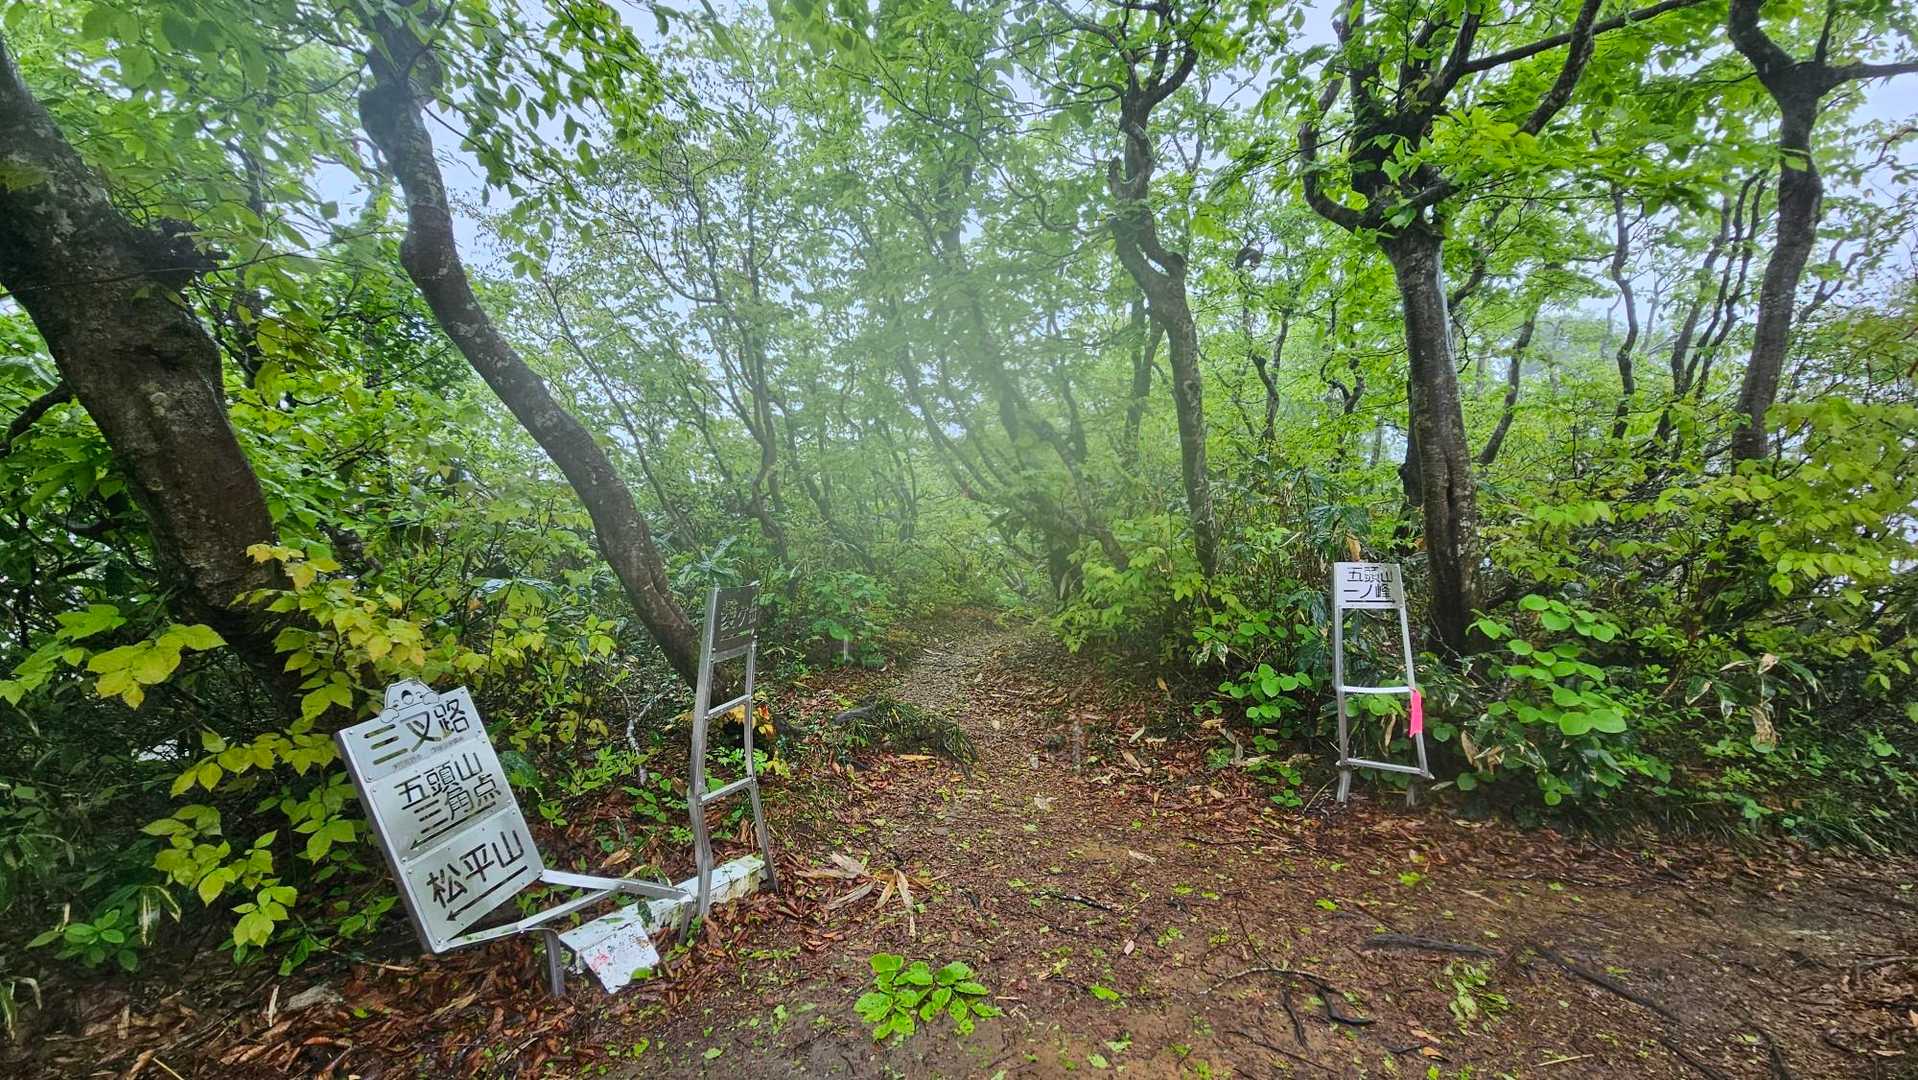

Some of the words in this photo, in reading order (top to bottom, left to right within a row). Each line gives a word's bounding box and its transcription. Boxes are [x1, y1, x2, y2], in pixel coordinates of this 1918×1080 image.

[363, 698, 470, 765] 三叉路
[394, 751, 483, 810] 五頭山
[413, 773, 501, 834] 三角点
[426, 830, 525, 909] 松平山
